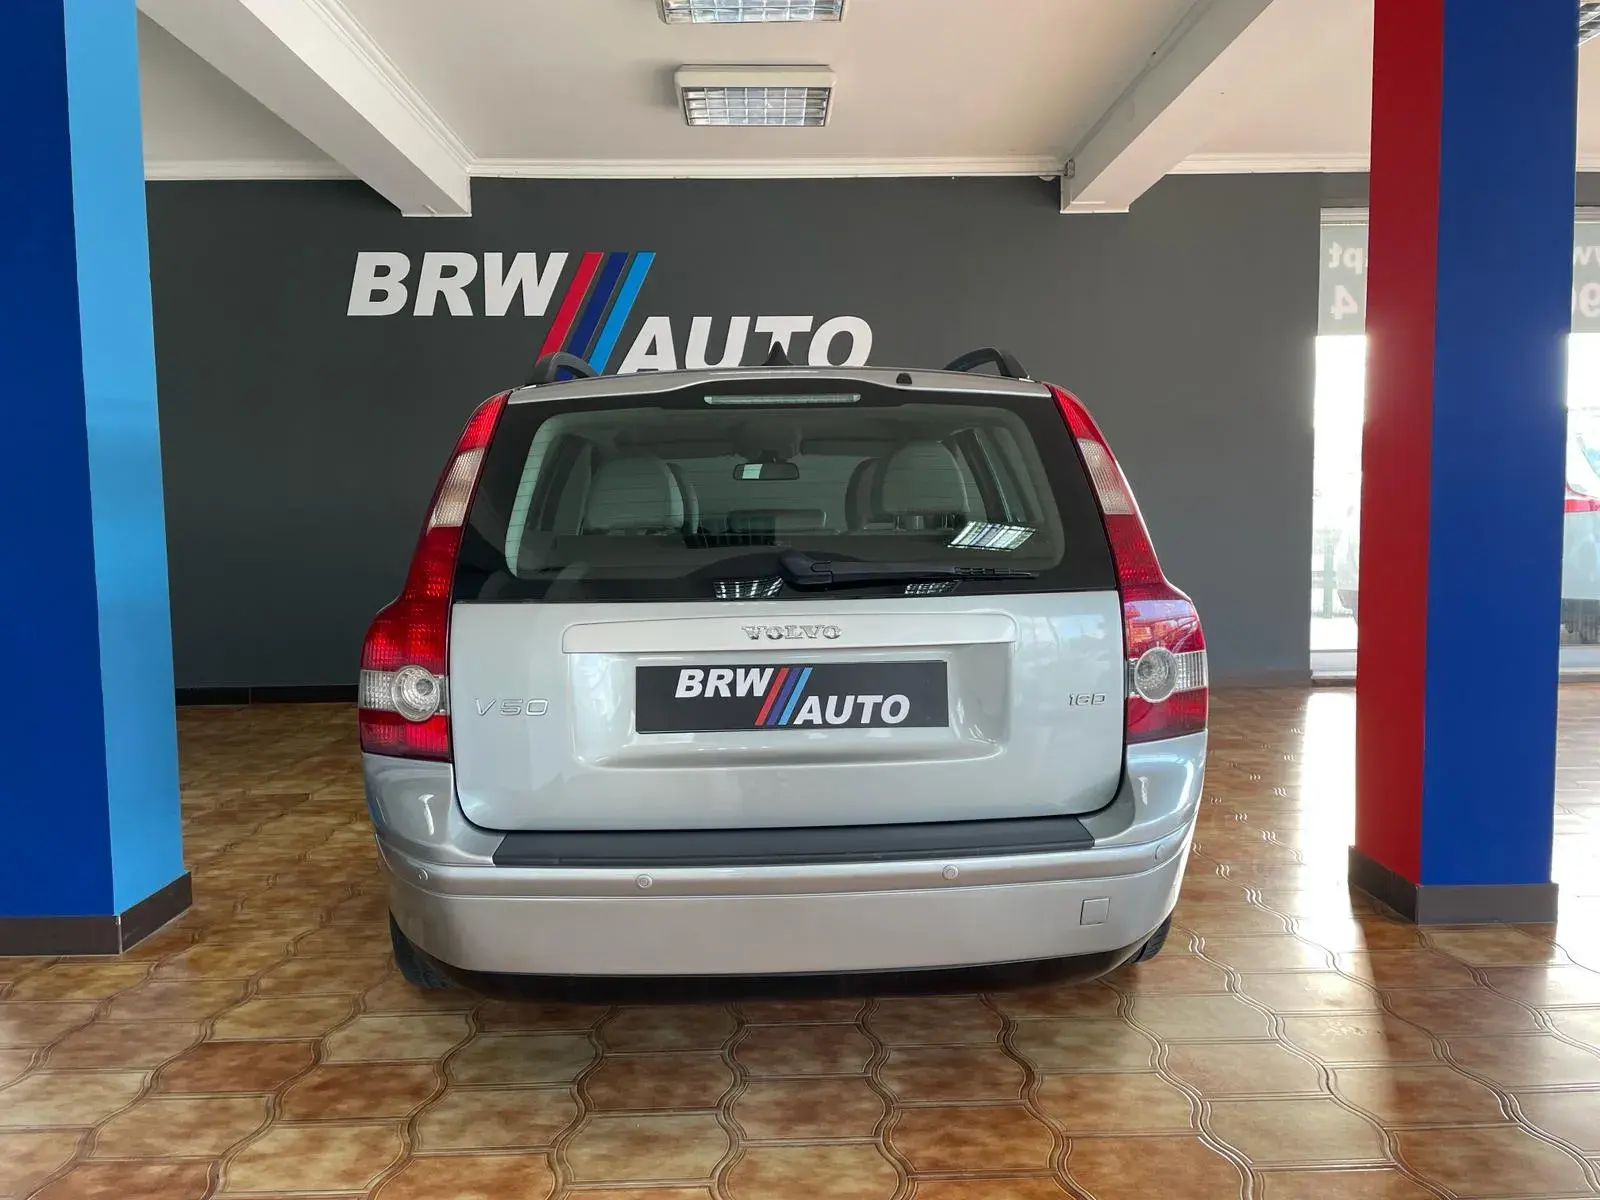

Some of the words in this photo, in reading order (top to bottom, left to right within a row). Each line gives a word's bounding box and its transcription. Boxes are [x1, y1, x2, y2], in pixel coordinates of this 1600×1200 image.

[346, 251, 569, 317] BRW
[616, 315, 873, 375] AUTO
[741, 624, 842, 640] VOLVO
[674, 667, 774, 698] BRW
[474, 697, 549, 717] V50
[792, 694, 910, 726] AUTO
